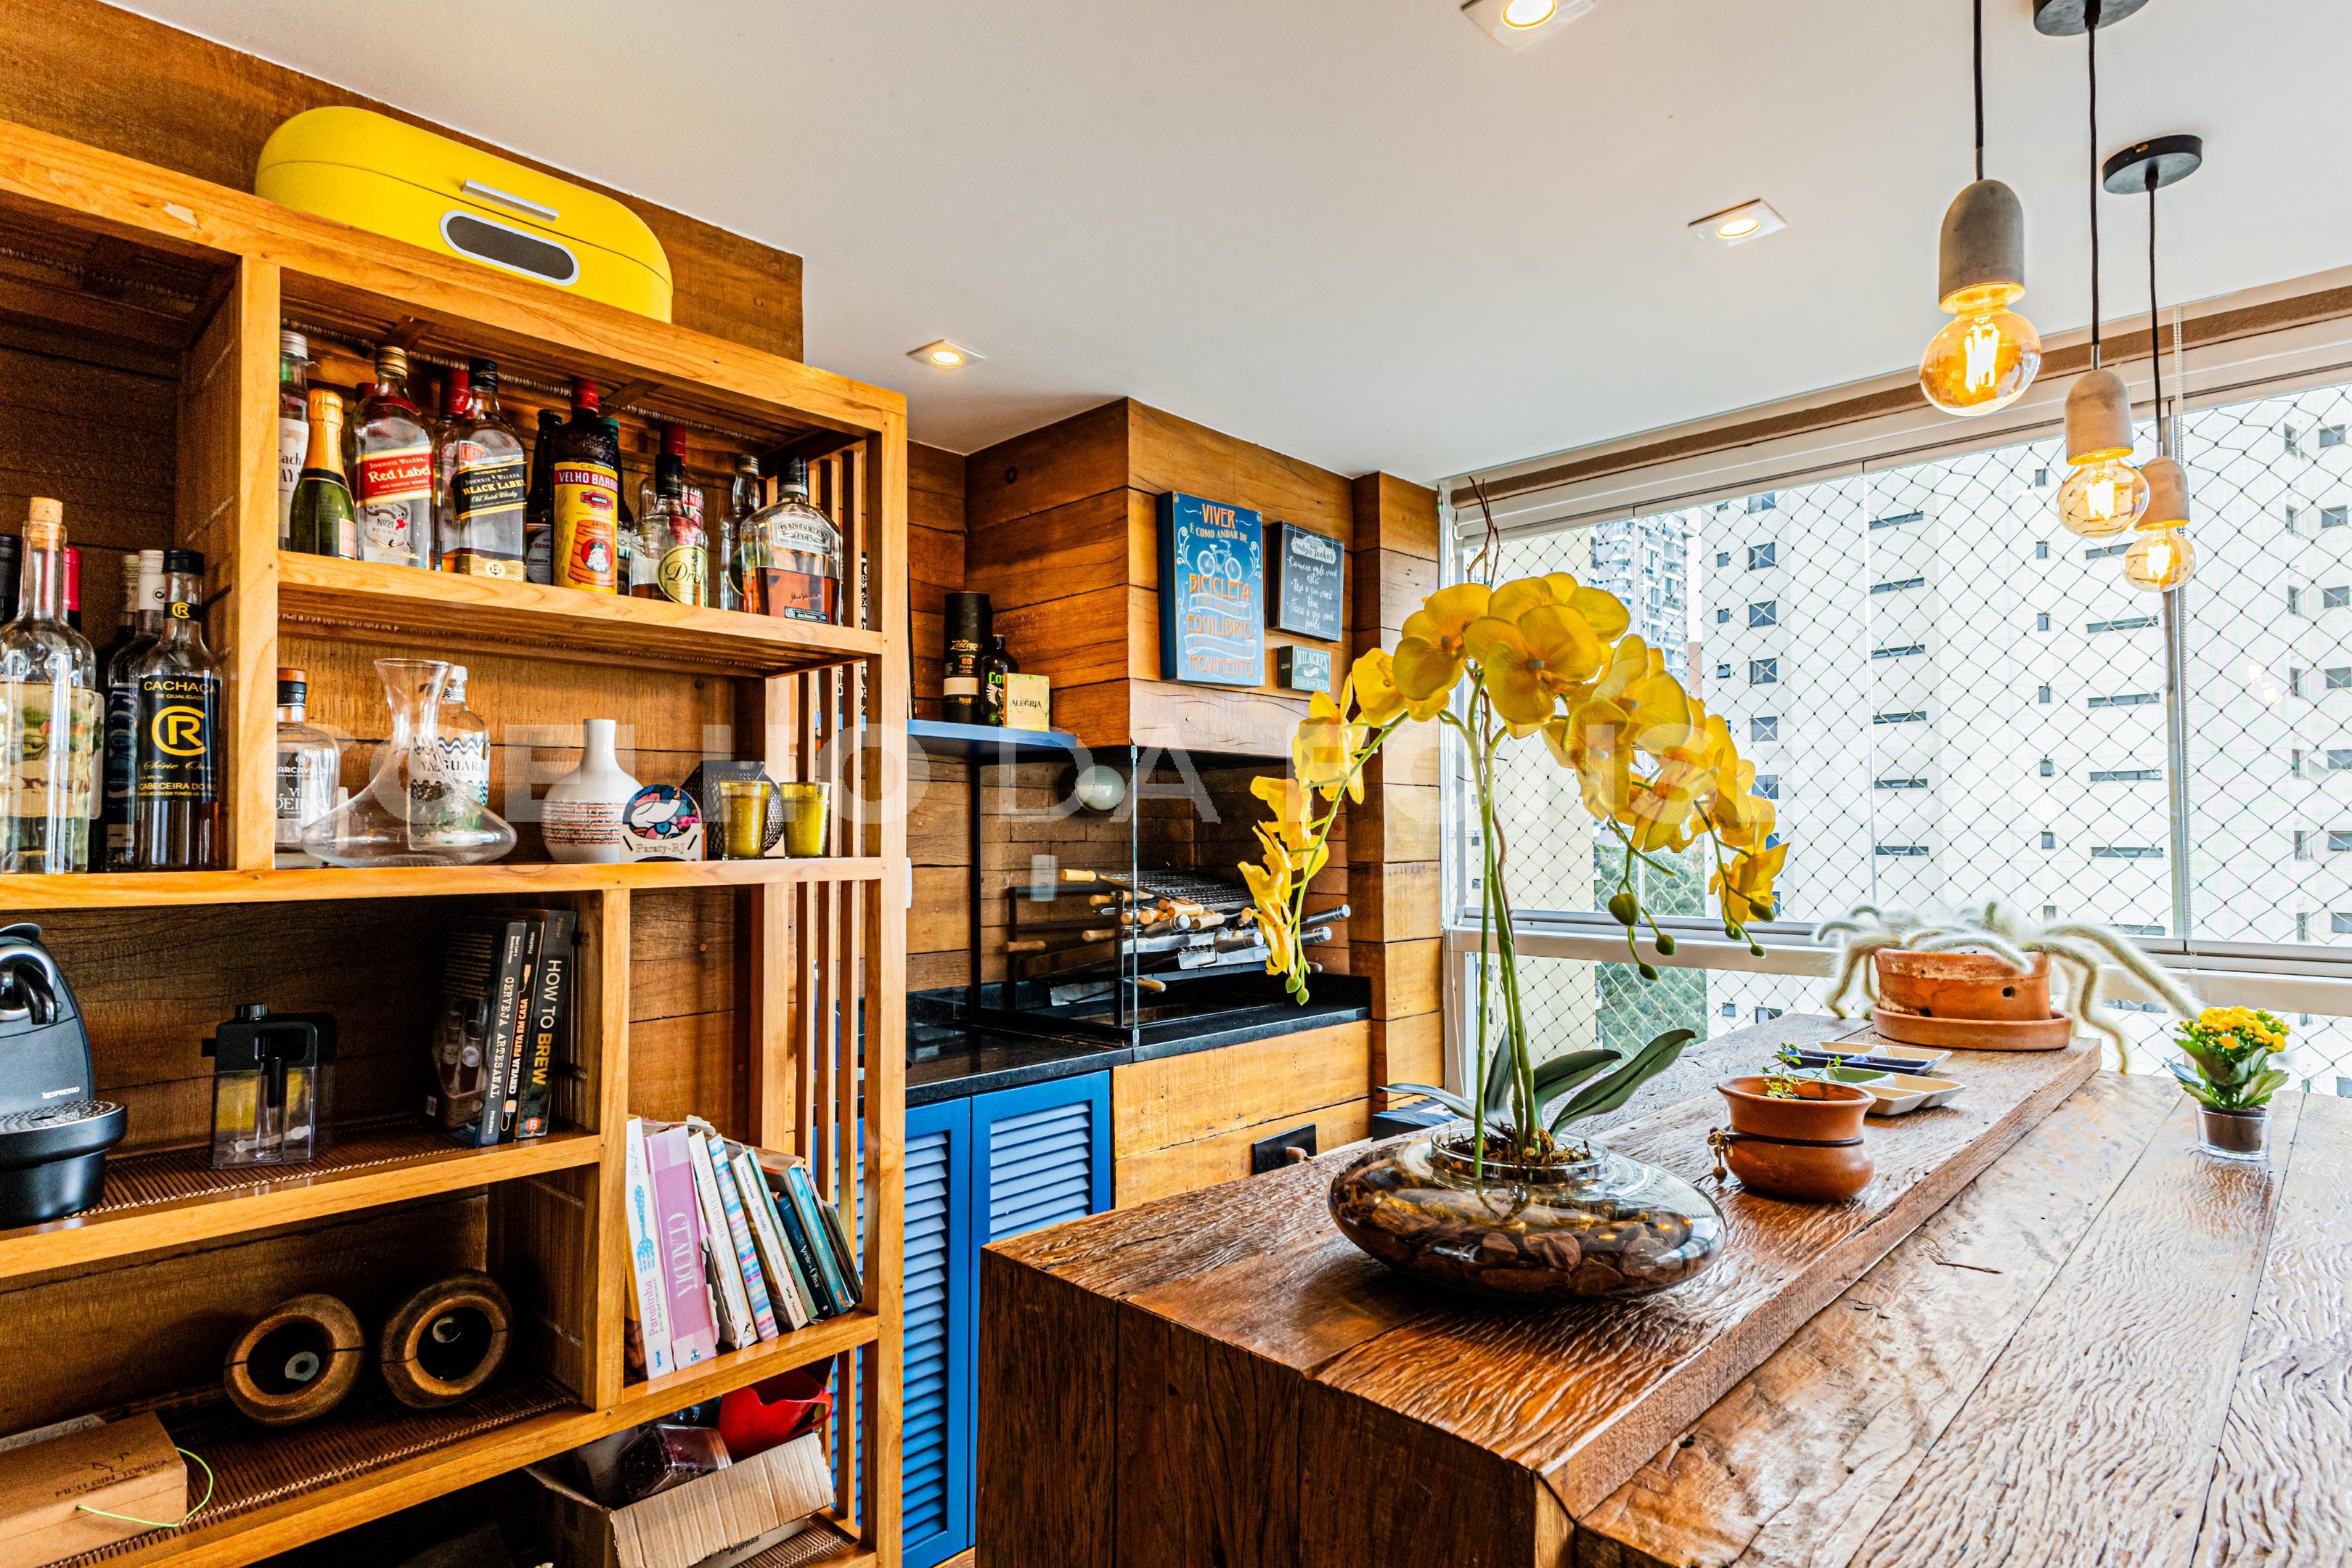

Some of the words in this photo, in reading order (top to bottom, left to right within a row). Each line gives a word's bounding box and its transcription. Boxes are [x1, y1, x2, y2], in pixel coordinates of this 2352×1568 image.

[367, 470, 397, 483] Red
[397, 465, 431, 478] Label
[465, 477, 491, 486] JOHNNIE
[559, 472, 589, 483] VELHO
[462, 483, 497, 495] BLACK
[497, 479, 526, 490] LABEL
[1202, 504, 1236, 529] VIVER
[780, 523, 828, 540] GENTLEMAN
[795, 532, 813, 542] JACK
[1196, 527, 1214, 539] COMO
[1217, 529, 1238, 539] ANDAR
[1240, 532, 1248, 543] DE
[1189, 573, 1251, 602] BICICLETA
[1187, 614, 1254, 640] EQUILÍBRIO
[1189, 656, 1255, 677] MOVIMENTO
[1297, 649, 1329, 674] MILAGRES
[144, 681, 216, 695] CACHAÇA
[1010, 699, 1042, 709] ALEGRIA
[139, 782, 190, 791] CABECEIRA
[636, 843, 685, 854] Paraty-RJ
[544, 960, 562, 1002] HOW
[499, 977, 515, 1027] CERVEJA
[518, 998, 528, 1021] CASA
[517, 1021, 526, 1034] EM
[540, 1006, 557, 1029] TO
[513, 1034, 524, 1058] FEITA
[490, 1033, 507, 1098] ARTESANAL
[532, 1033, 553, 1086] BREW
[509, 1058, 521, 1095] CERVEJA
[41, 1086, 80, 1100] NESPRESSO
[707, 1191, 724, 1240] CULINÁRIA
[667, 1213, 698, 1299] CLAUDIA
[800, 1244, 813, 1265] Azeite
[809, 1268, 820, 1289] Oliva
[643, 1278, 659, 1337] Panelinha
